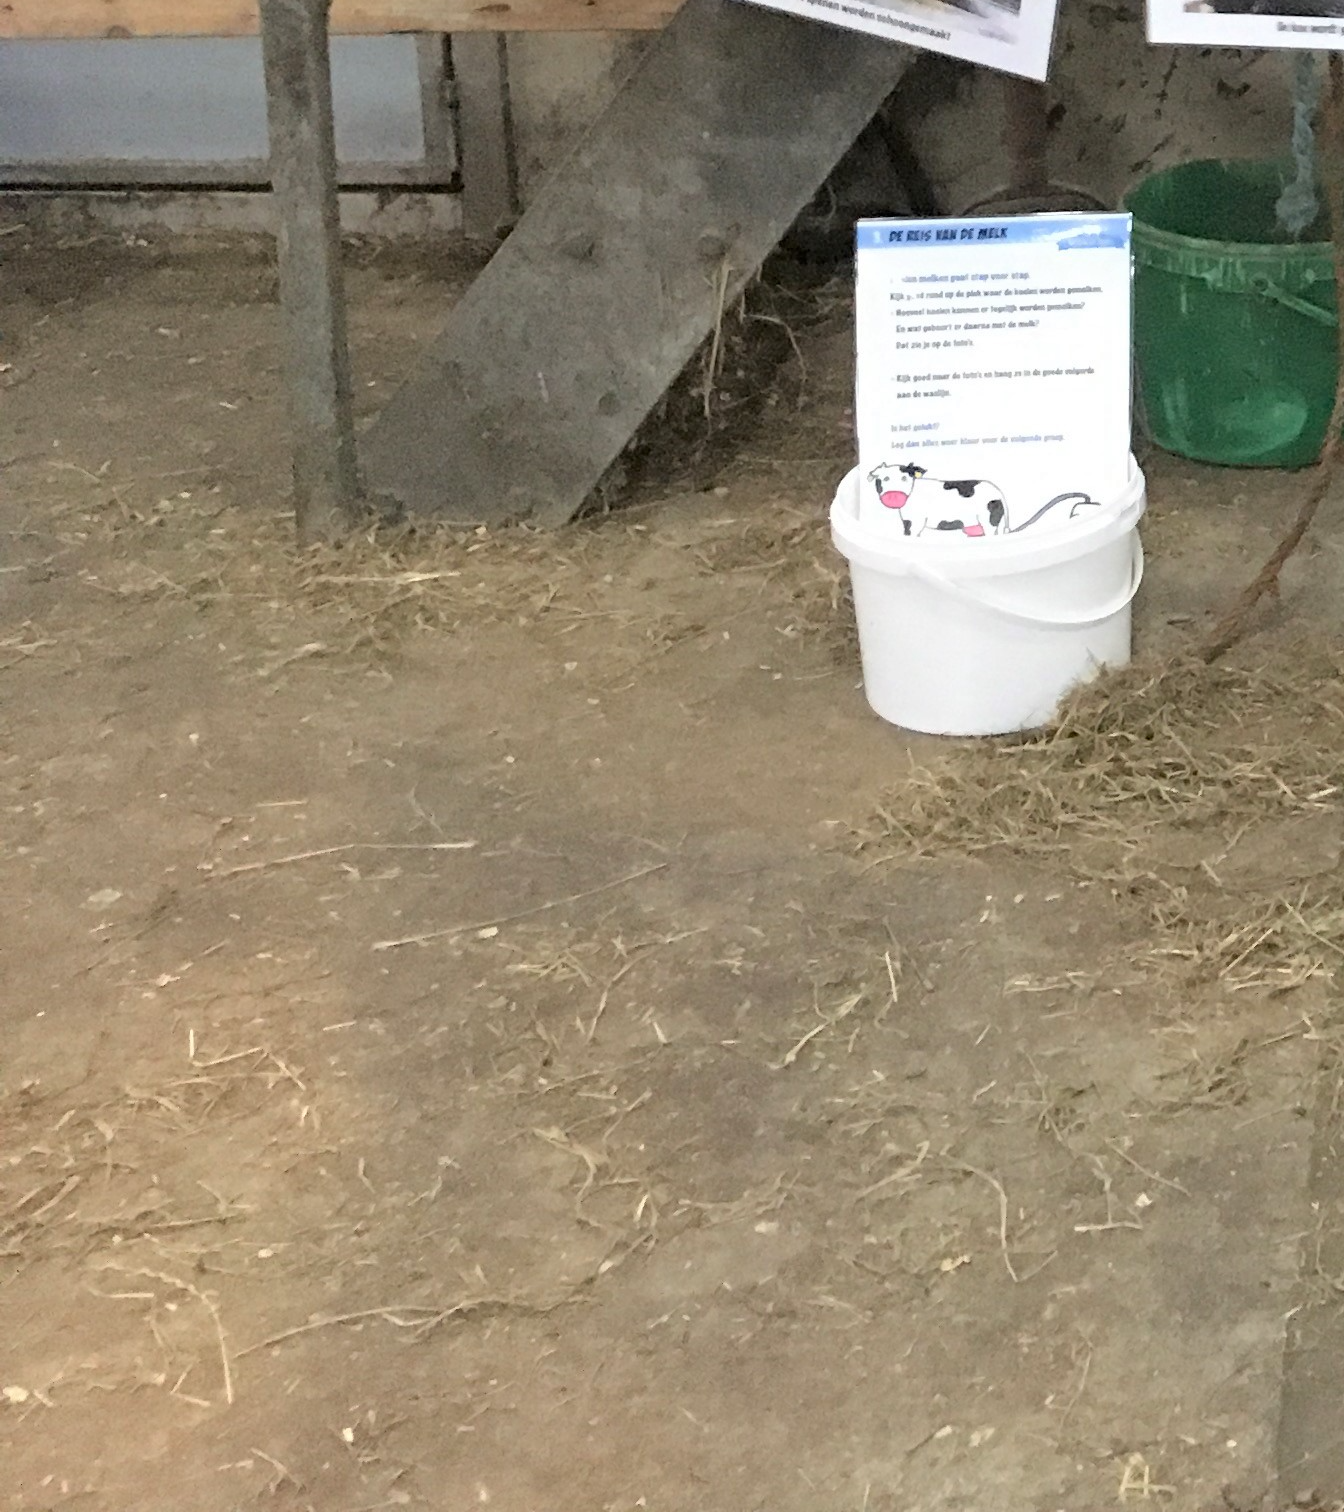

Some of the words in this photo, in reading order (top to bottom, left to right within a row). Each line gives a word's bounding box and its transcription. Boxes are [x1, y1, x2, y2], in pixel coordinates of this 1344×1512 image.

[889, 230, 903, 242] DE
[907, 229, 931, 242] REIS
[935, 228, 957, 240] VAN
[960, 227, 974, 240] DE
[977, 227, 1008, 240] MELK
